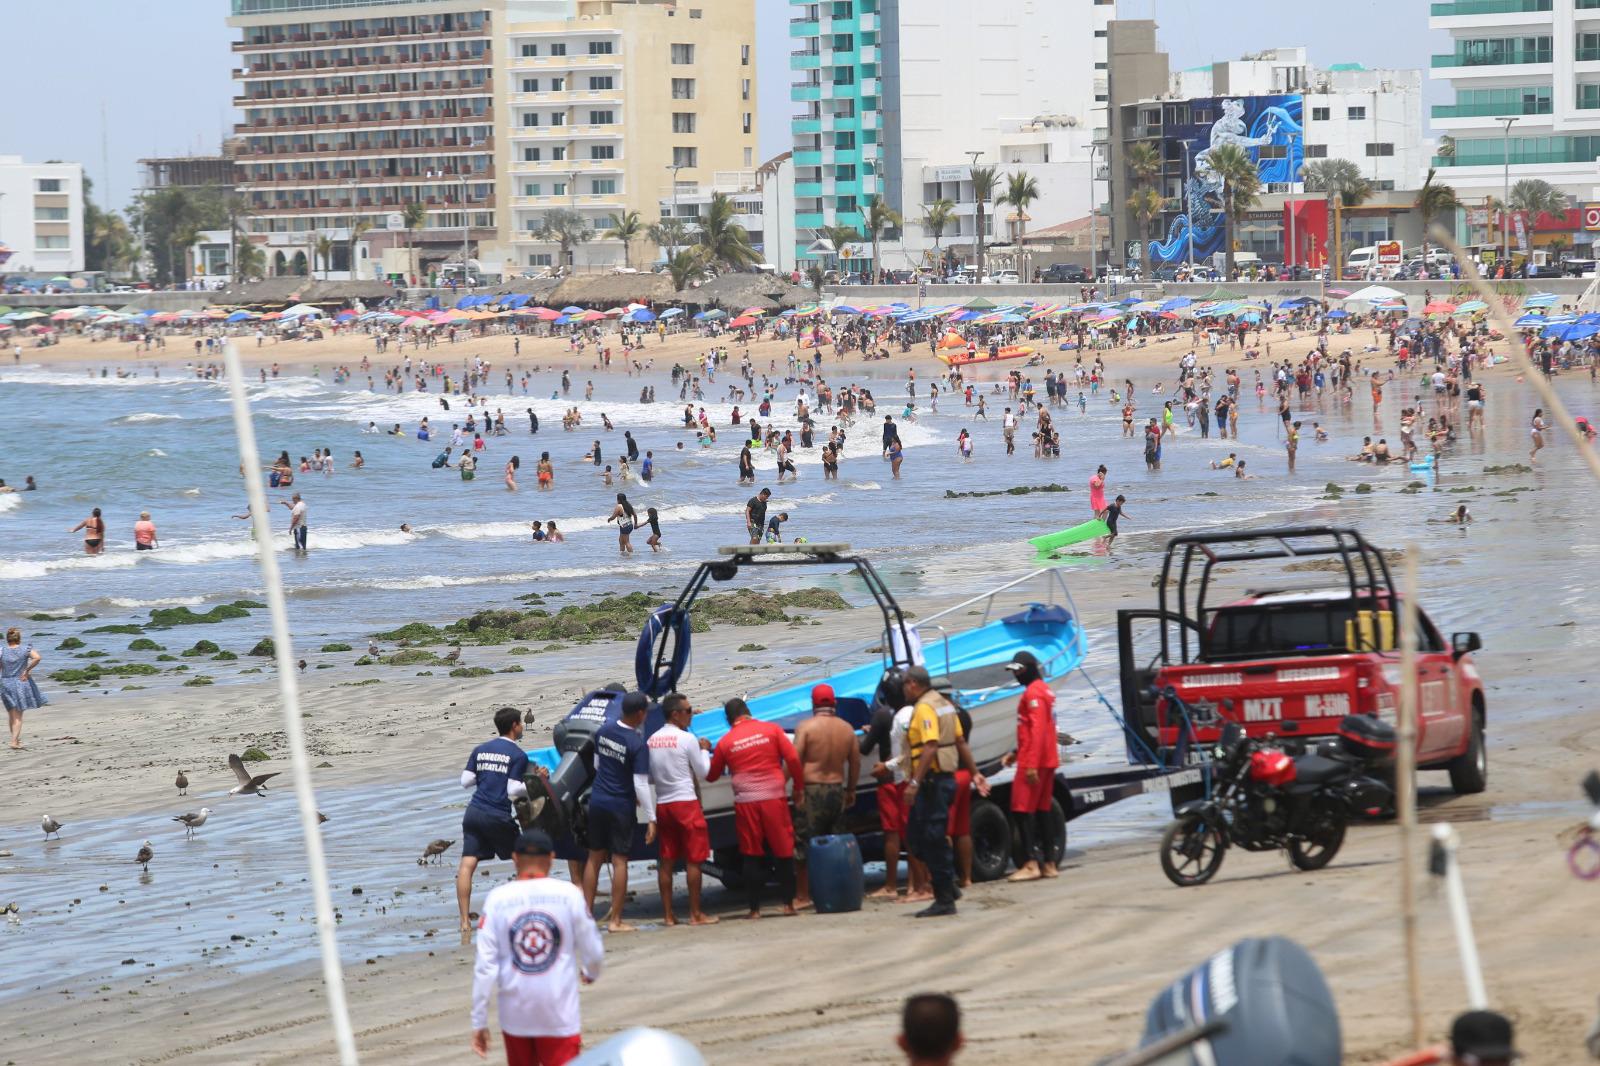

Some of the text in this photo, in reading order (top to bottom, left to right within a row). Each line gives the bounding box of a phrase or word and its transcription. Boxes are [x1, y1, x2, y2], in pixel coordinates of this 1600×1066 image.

[1182, 666, 1341, 689] SALVAVIDAS LIFEGUARD
[1242, 697, 1283, 722] MZT
[598, 735, 627, 755] BOMBEROS
[730, 737, 770, 753] VOLUNTEER
[476, 752, 511, 764] BOMBEROS
